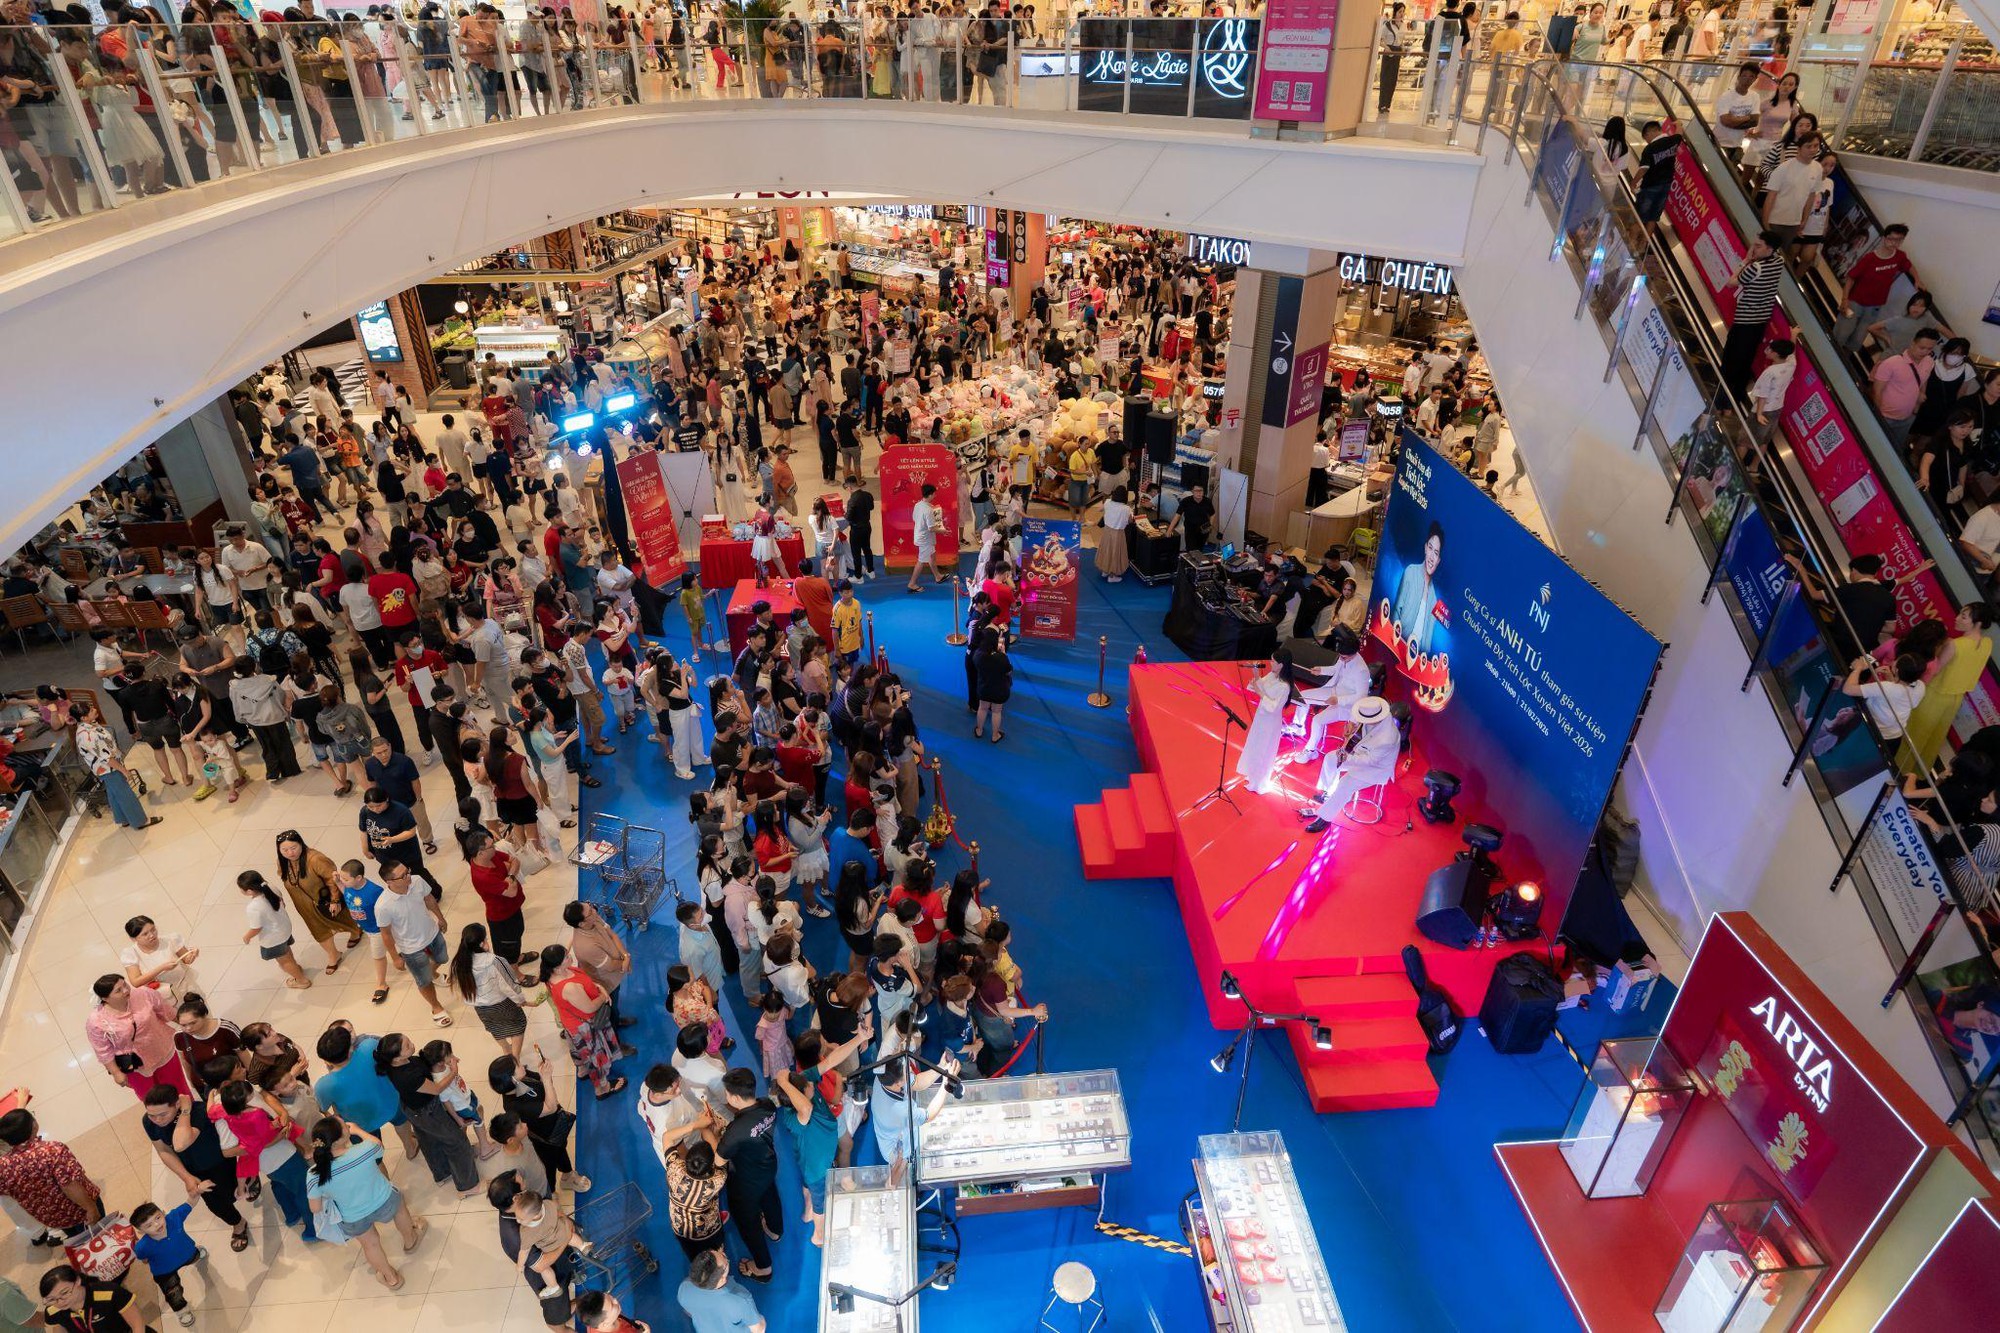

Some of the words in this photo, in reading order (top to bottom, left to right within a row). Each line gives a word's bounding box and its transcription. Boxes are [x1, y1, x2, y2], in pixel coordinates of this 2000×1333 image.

[1142, 52, 1188, 79] Lucie
[1670, 178, 1700, 232] OUCHER
[1684, 172, 1710, 218] WAON
[1340, 254, 1366, 283] GÀ
[1382, 262, 1451, 295] CHIÊN
[1650, 308, 1669, 345] Greate
[1529, 600, 1550, 633] PNJ
[1462, 610, 1481, 634] Chuỗi
[1481, 628, 1493, 649] Tọa
[1492, 642, 1504, 661] Độ
[1504, 654, 1520, 677] Tích
[1518, 672, 1533, 692] Lộc
[1572, 732, 1593, 758] 2026
[1464, 587, 1480, 613] Cung
[1480, 606, 1490, 621] Ca
[1496, 618, 1524, 654] ANH
[1524, 642, 1542, 672] TÚ
[1541, 670, 1562, 696] tham
[1575, 706, 1586, 723] sự
[1586, 716, 1606, 744] kiện
[1519, 699, 1550, 738] 21/02/2026
[1882, 812, 1925, 889] Everyday
[1894, 806, 1931, 868] Greater
[1749, 996, 1832, 1102] ARTA
[1794, 1072, 1807, 1090] by
[1806, 1085, 1828, 1114] PNJ
